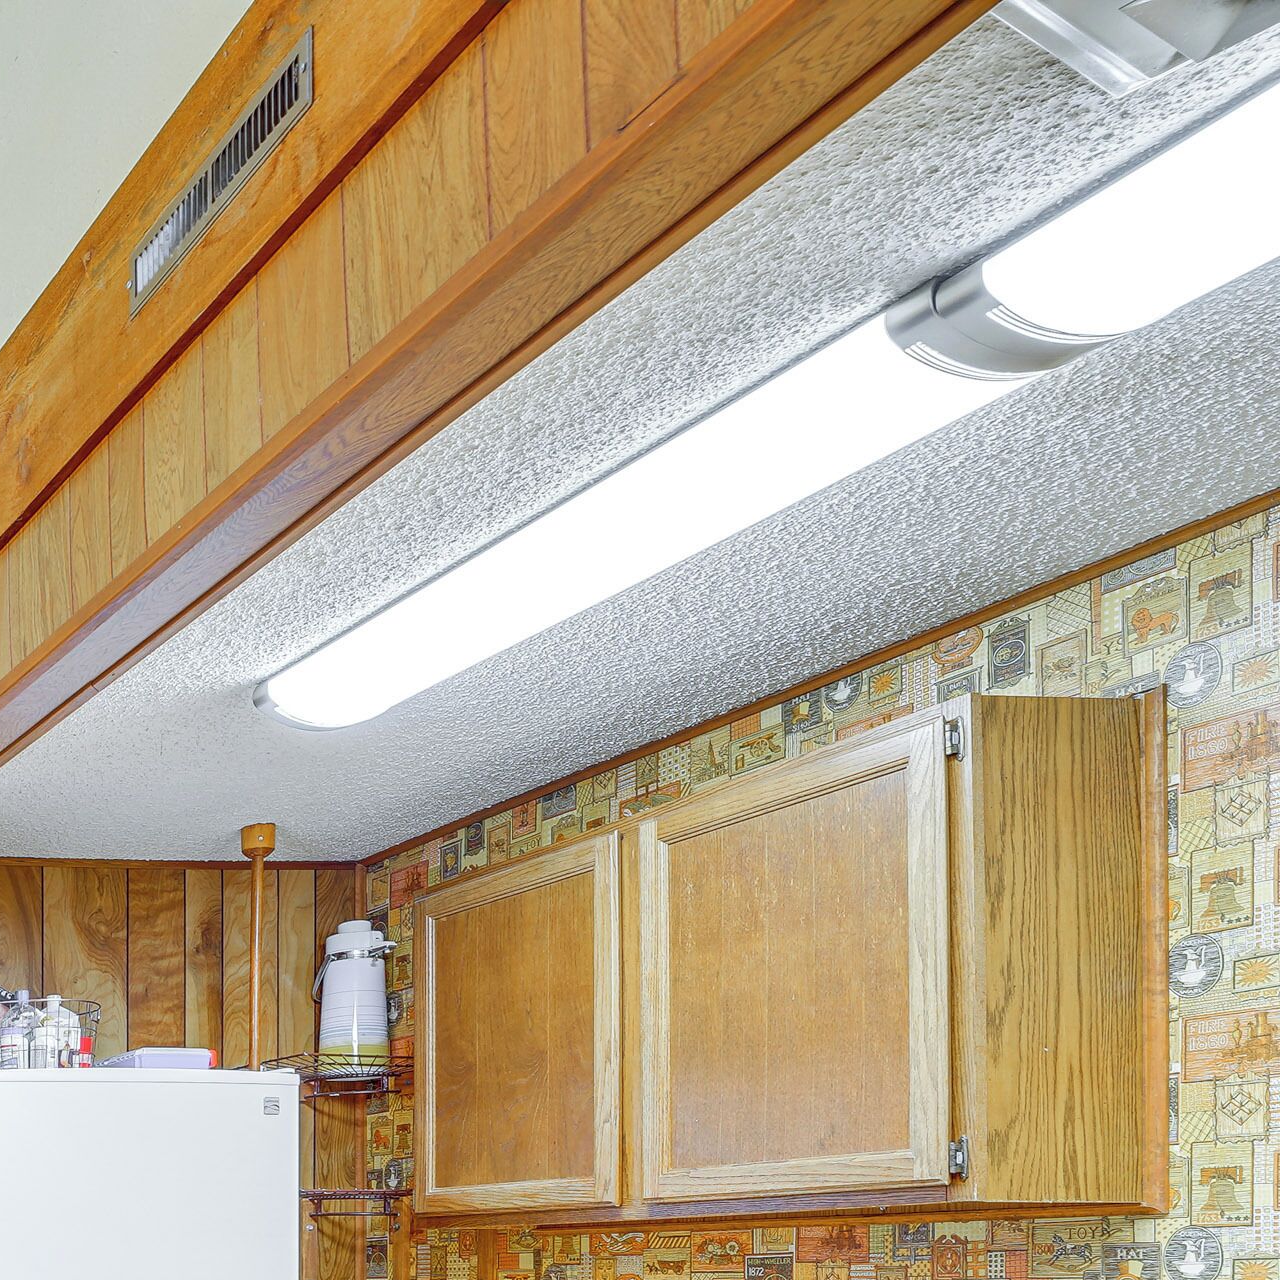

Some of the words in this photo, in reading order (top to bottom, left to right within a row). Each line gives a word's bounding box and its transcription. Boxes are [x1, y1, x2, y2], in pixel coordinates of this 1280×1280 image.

[1188, 1018, 1227, 1034] FIRE
[1065, 1226, 1099, 1239] TOY
[1116, 1246, 1144, 1259] HAT
[748, 1266, 765, 1277] 1872
